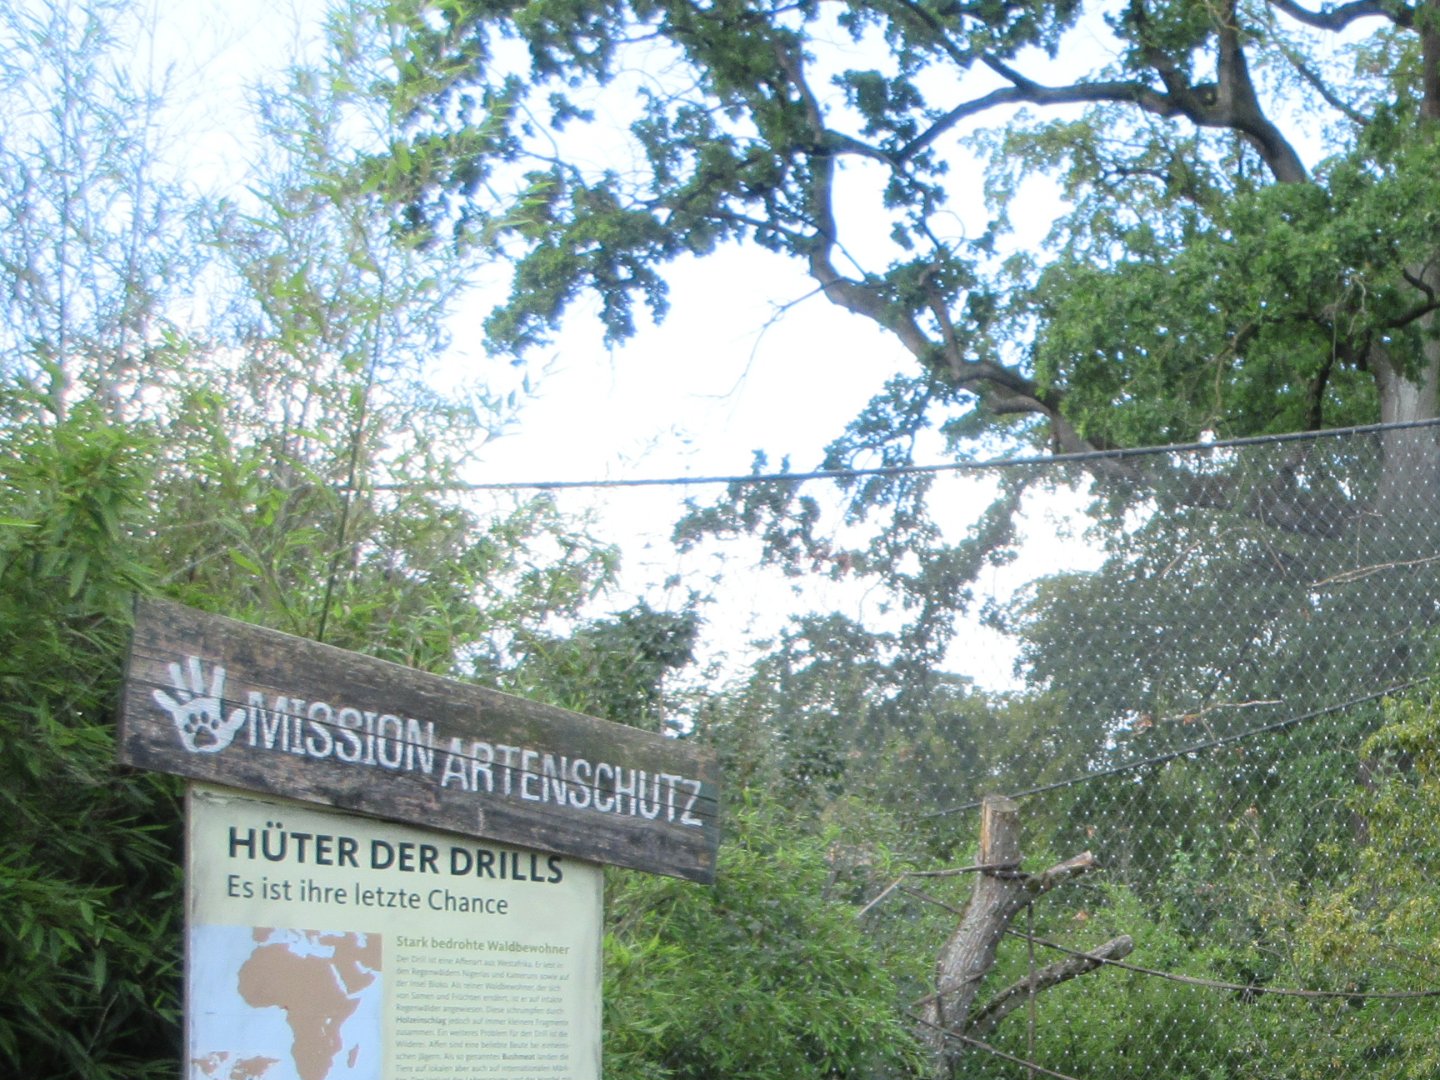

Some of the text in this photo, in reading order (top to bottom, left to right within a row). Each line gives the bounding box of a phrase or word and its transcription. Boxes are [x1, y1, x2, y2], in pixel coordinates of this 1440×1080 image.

[247, 690, 703, 827] MISSION ARTENSCHUTZ
[228, 820, 564, 884] HÜTER DER DRILLS
[227, 874, 509, 915] Es ist ihre letzte Chance
[396, 935, 571, 956] Stark bedrohte Waldbewohner
